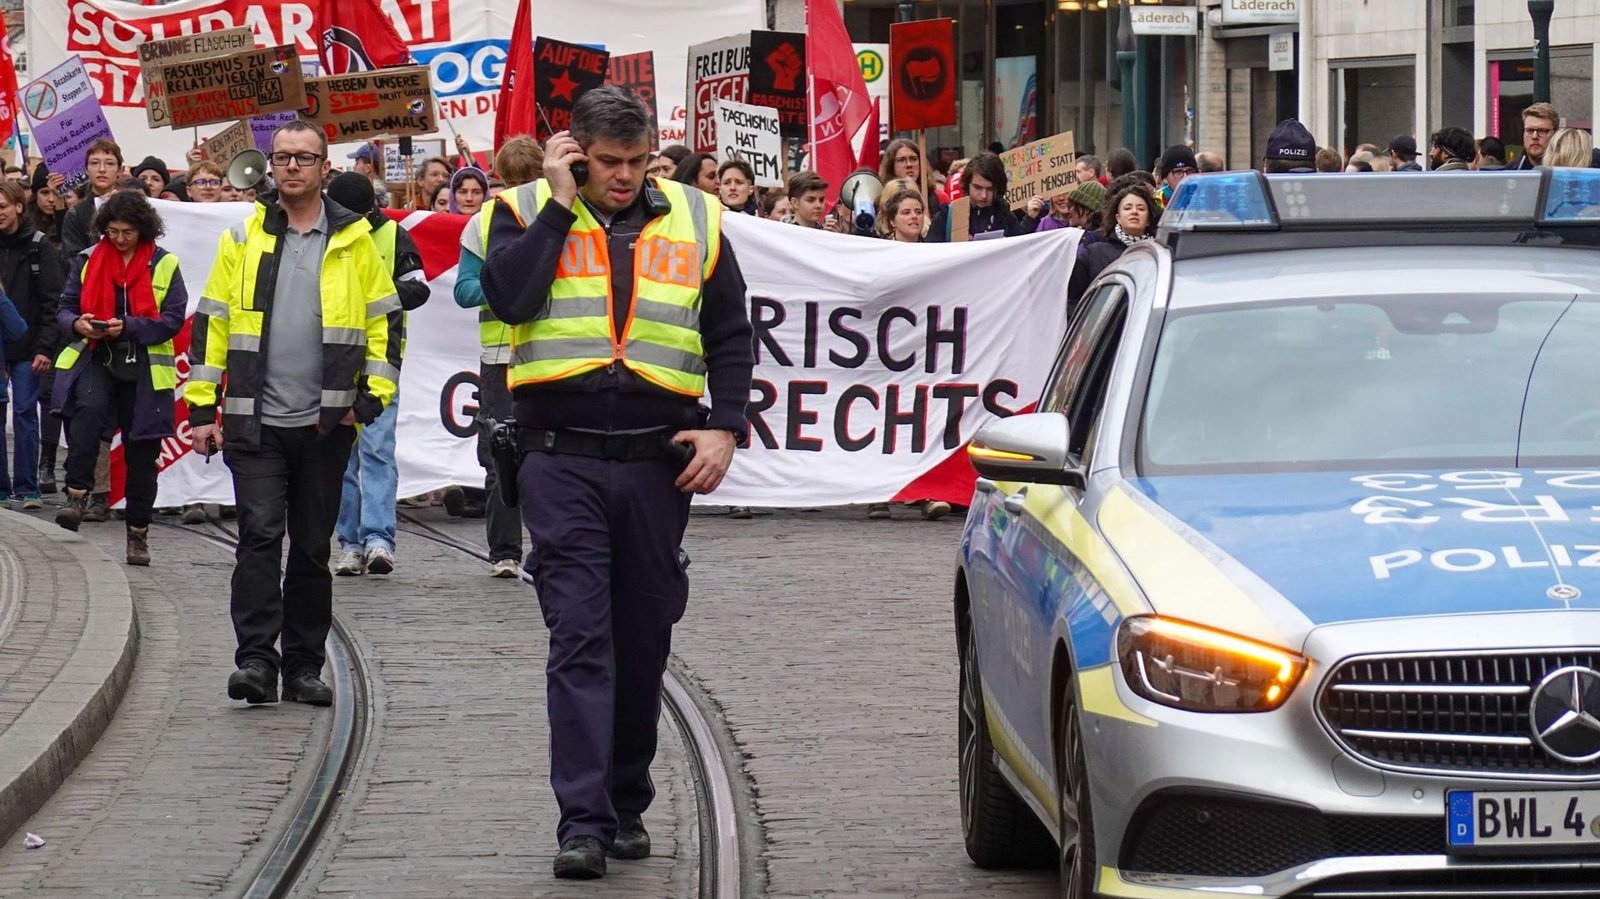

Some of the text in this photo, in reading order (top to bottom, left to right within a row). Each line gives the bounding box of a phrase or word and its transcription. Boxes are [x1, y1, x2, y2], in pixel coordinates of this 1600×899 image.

[194, 34, 246, 53] FLASCHEN
[53, 66, 82, 88] Bezahlkarte
[163, 53, 266, 80] FASCHISMUS ZU
[695, 46, 751, 81] FREIBUR
[166, 67, 265, 94] RELATIVIEREN
[259, 80, 277, 92] FCK
[327, 77, 367, 92] HEBEN
[373, 74, 420, 89] UNSERE
[60, 118, 73, 130] Für
[339, 120, 370, 136] WIE
[372, 115, 428, 131] DAMALS
[720, 107, 779, 135] FASCHISMUS
[44, 136, 69, 153] soziale
[69, 121, 95, 138] Rechte
[46, 127, 110, 166] Selbstbestimmung
[735, 130, 758, 149] HAT
[1049, 152, 1073, 168] STATT
[1004, 170, 1077, 204] RECHTE MENSCHEN
[563, 234, 695, 285] OLIZEI
[750, 296, 968, 374] RISCH
[1457, 823, 1467, 836] D
[1478, 796, 1586, 838] BWL 4
